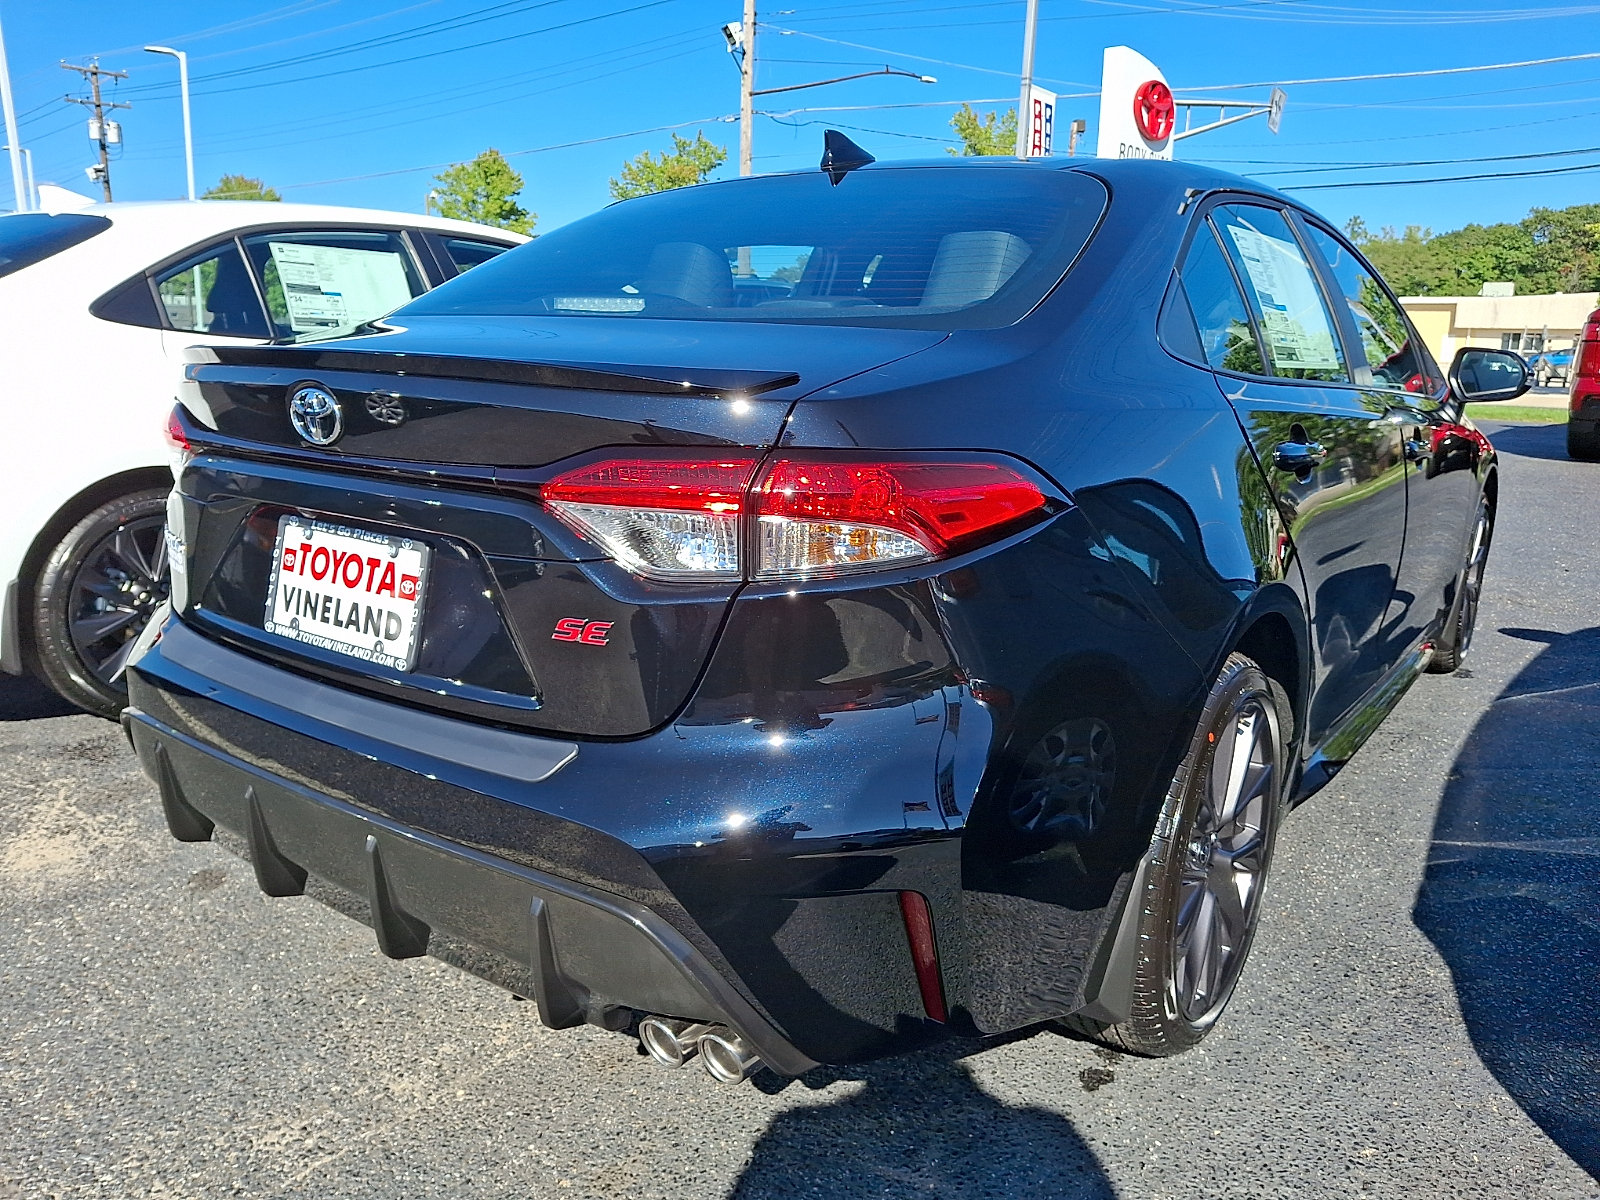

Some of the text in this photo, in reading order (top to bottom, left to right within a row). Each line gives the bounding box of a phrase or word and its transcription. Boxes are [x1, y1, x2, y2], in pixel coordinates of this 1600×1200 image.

[311, 520, 389, 544] Let's Go Places
[265, 537, 281, 607] TOYOTA
[299, 542, 396, 598] TOYOTA
[283, 584, 403, 641] VINELAND
[408, 567, 424, 645] TOYOTA
[551, 617, 615, 646] SE
[275, 624, 395, 667] WWW.TOYOTAVINELAND.COM
